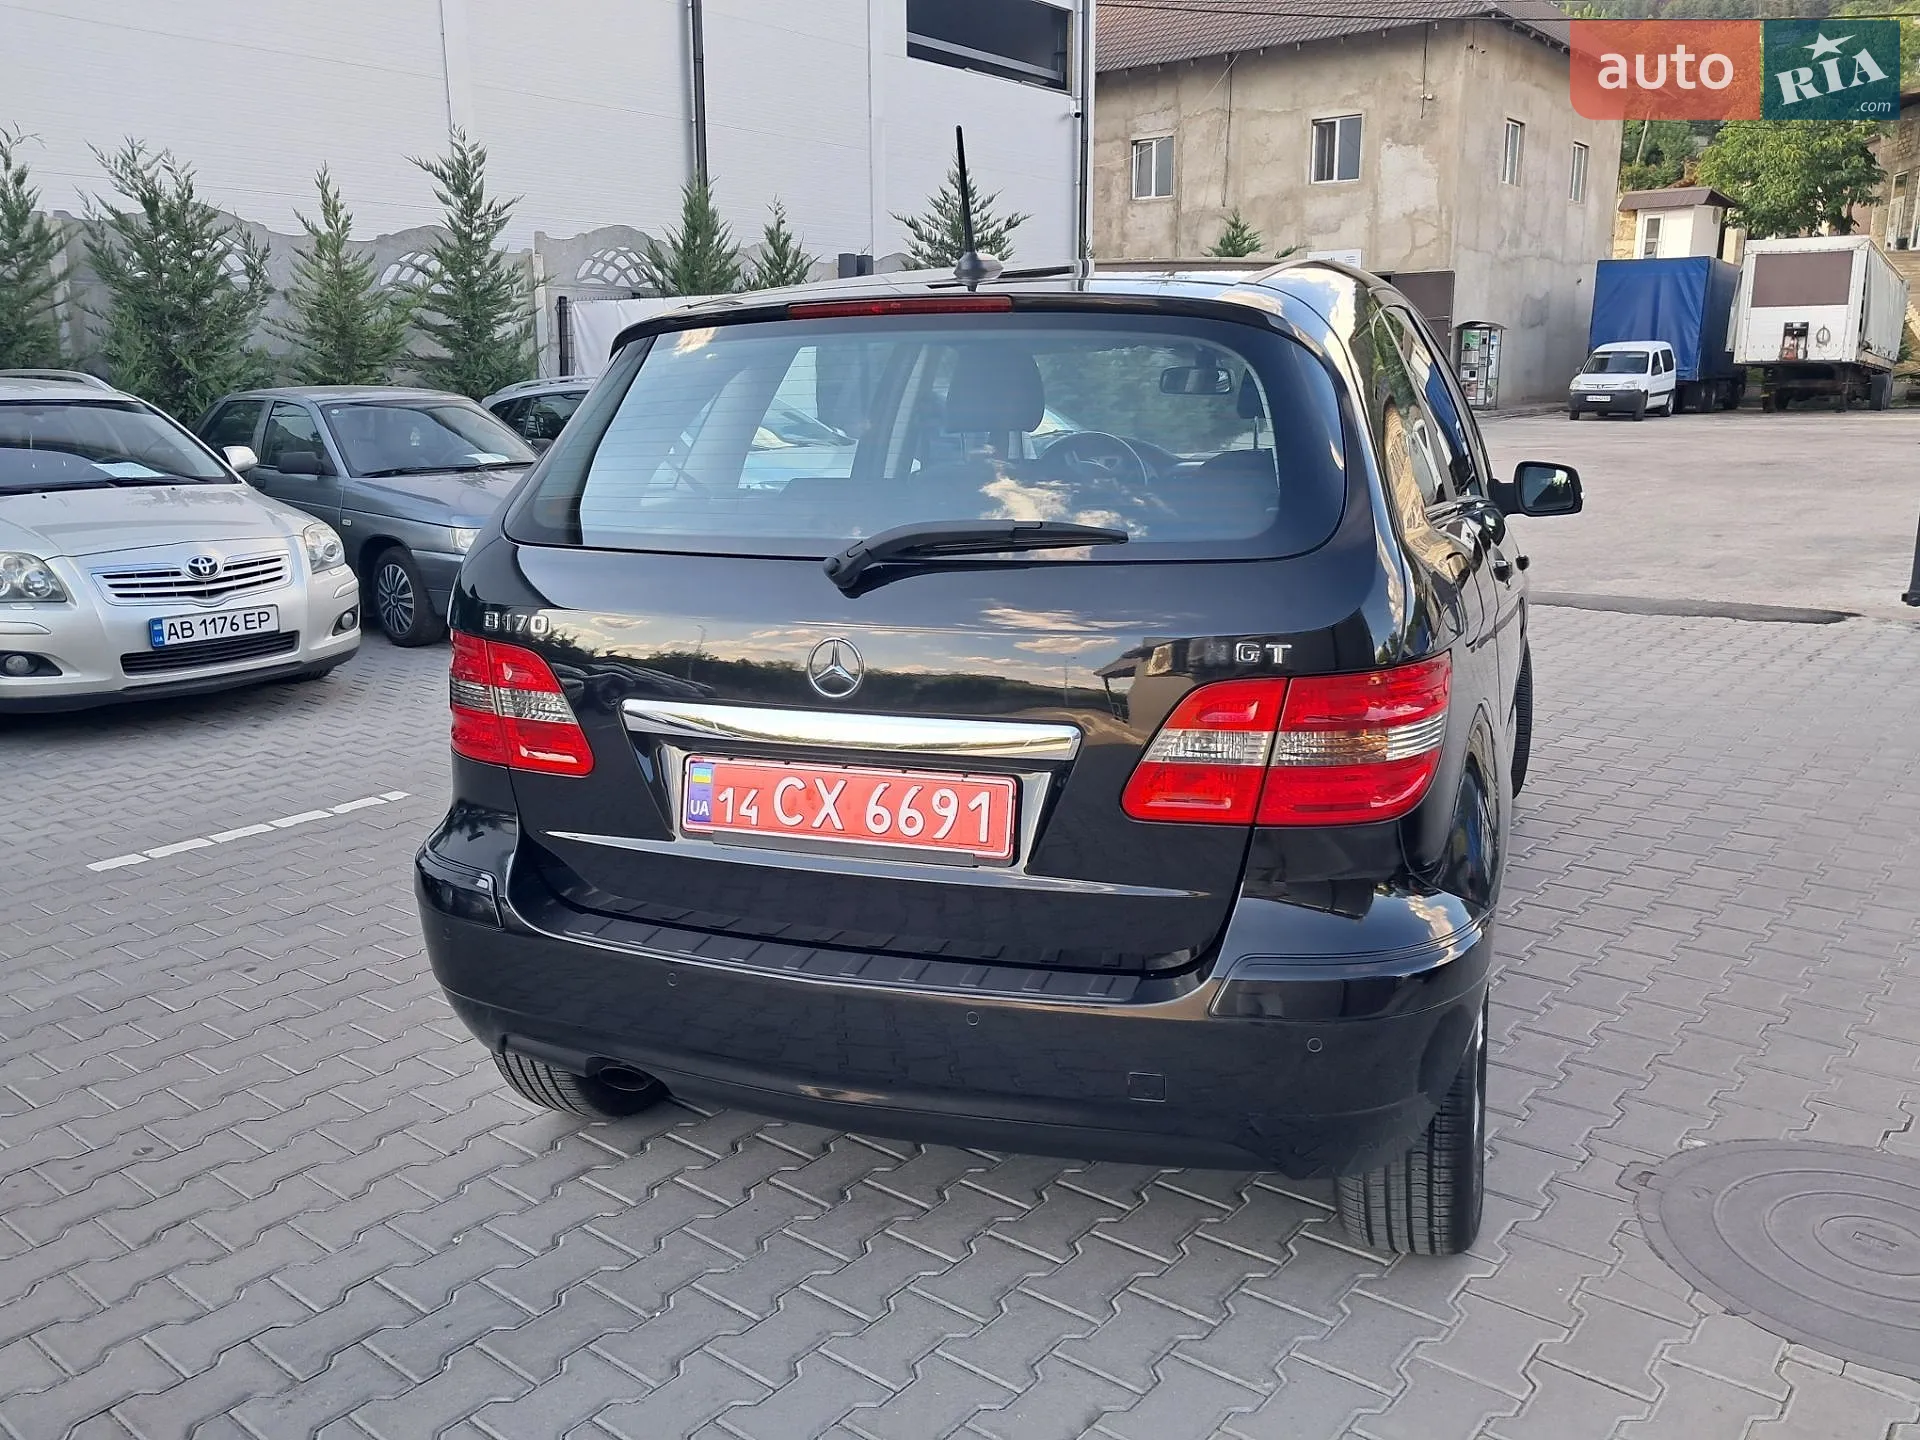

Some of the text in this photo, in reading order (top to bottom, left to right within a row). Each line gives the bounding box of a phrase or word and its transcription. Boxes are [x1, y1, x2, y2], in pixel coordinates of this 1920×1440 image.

[167, 611, 271, 641] AB 1176 EP
[690, 799, 710, 816] UA
[717, 776, 992, 844] 14 CX 6691
